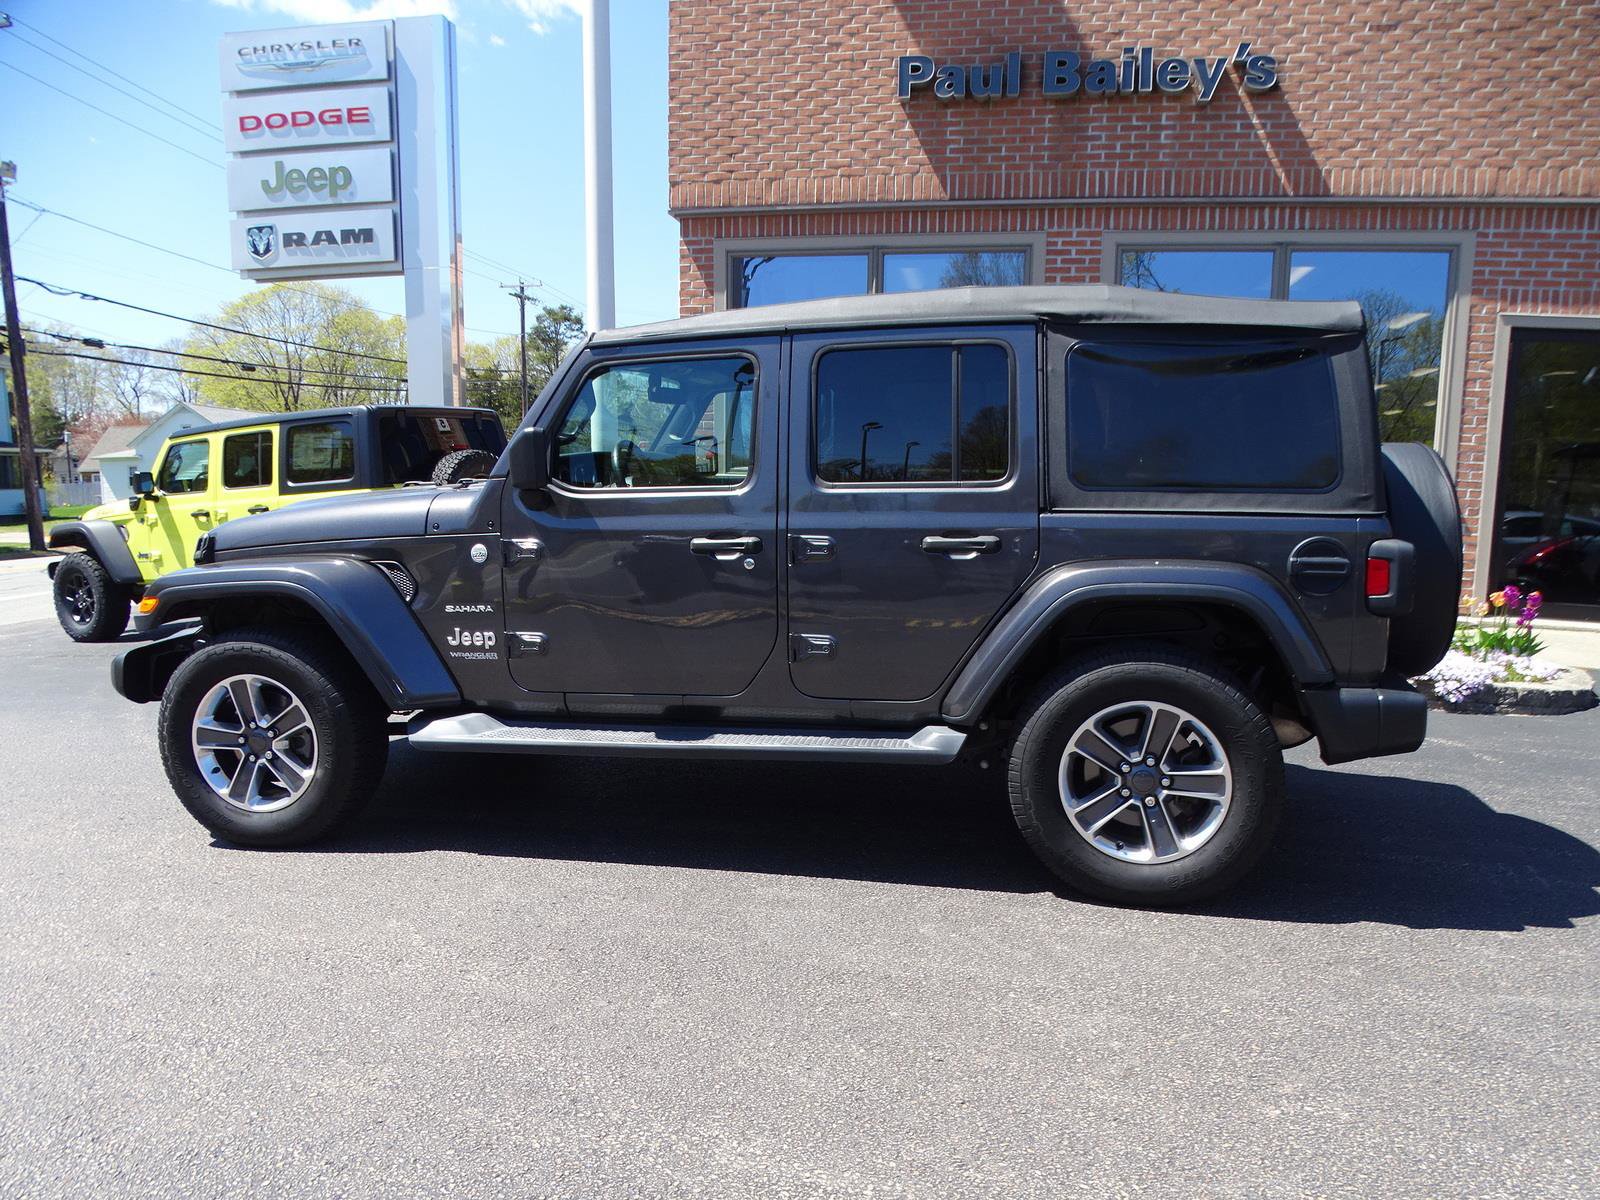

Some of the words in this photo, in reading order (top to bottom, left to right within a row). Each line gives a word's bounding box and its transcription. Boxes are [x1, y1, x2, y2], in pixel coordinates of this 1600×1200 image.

[238, 38, 362, 57] CHRYSLER
[897, 51, 1021, 99] Paul
[1042, 42, 1280, 102] Bailey's
[239, 107, 370, 132] DODGE
[261, 160, 352, 198] Jeep
[282, 228, 374, 248] RAM
[445, 605, 493, 613] SAHARA
[447, 627, 496, 649] Jeep
